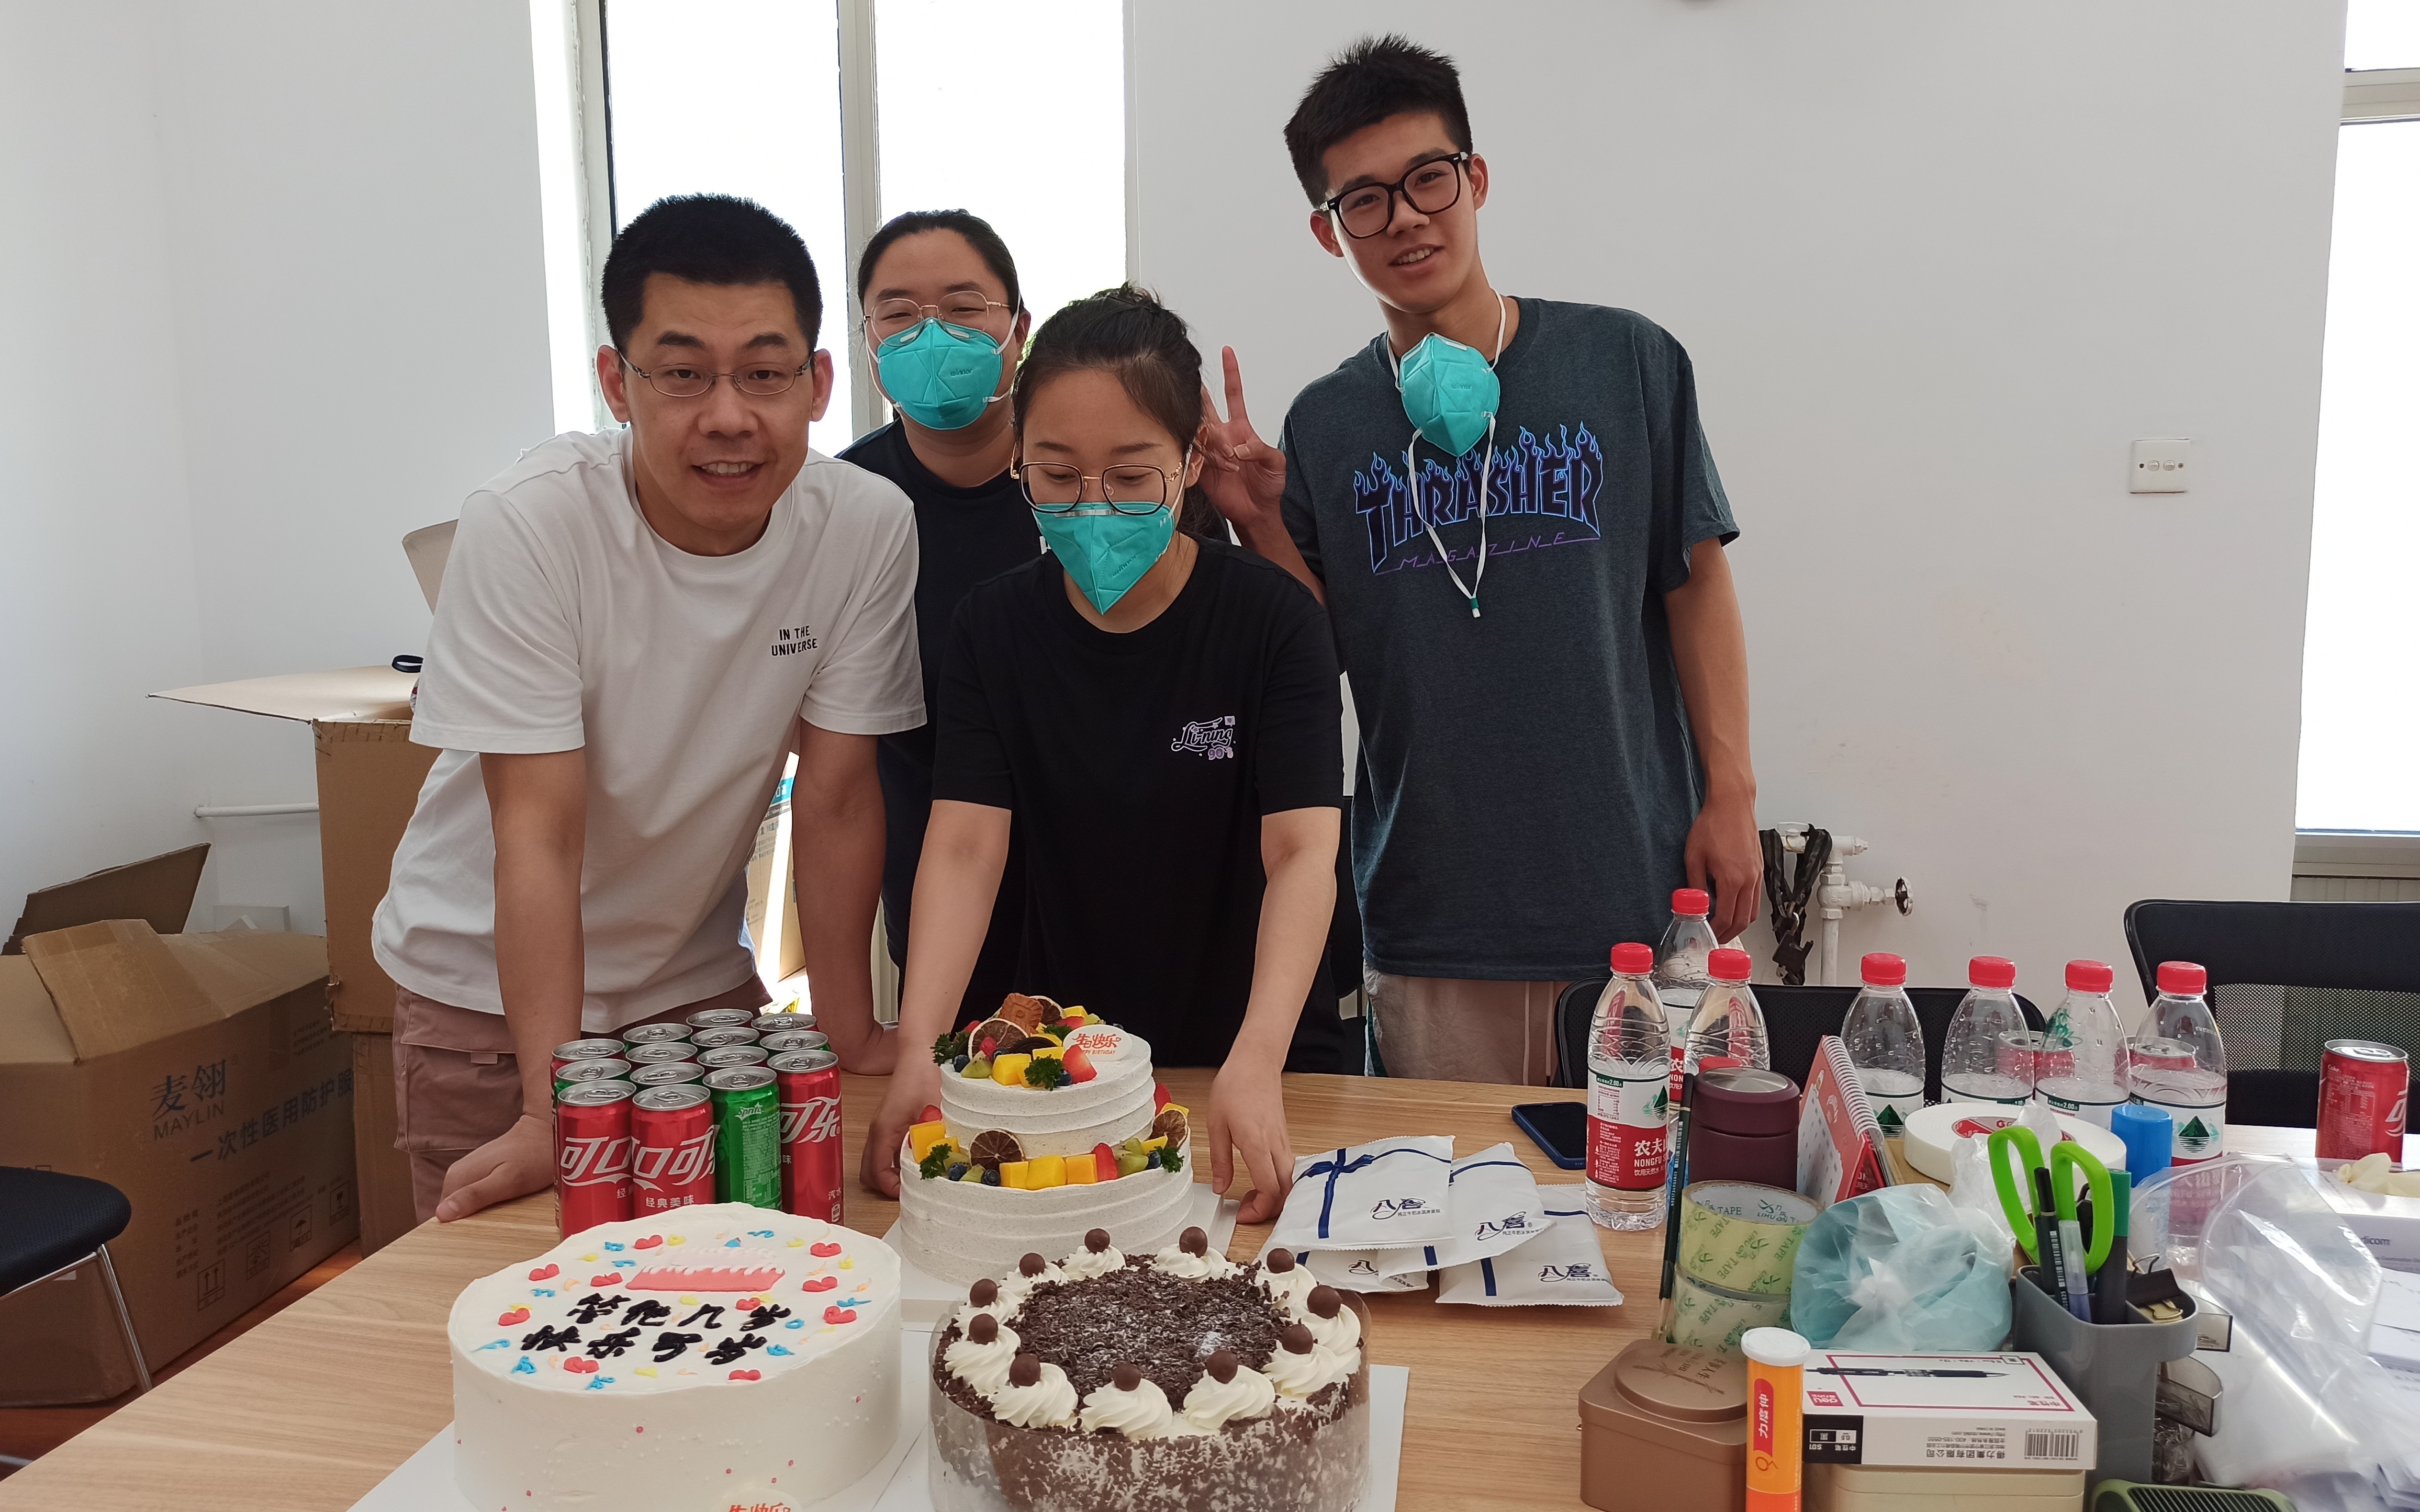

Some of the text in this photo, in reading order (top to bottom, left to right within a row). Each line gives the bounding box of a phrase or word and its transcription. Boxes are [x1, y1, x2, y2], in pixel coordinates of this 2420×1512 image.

[950, 368, 972, 377] winner
[1353, 421, 1604, 573] THRASHER
[1399, 532, 1565, 571] MAGAZINE
[779, 625, 810, 641] IN THE
[771, 638, 817, 657] UNIVERSE
[1072, 1033, 1122, 1049] 生日快乐
[154, 1102, 224, 1141] MAYLIN
[190, 1068, 354, 1163] 一次性医用防护服
[1634, 1155, 1662, 1168] NONGFU
[645, 1194, 694, 1208] 经典美味
[1371, 1198, 1426, 1219] 八喜
[1718, 1206, 1742, 1215] TAPE
[1475, 1211, 1527, 1240] 八喜
[2360, 1235, 2391, 1246] dicom
[1349, 1259, 1378, 1275] 八
[1538, 1263, 1592, 1282] 八喜
[1758, 1393, 1769, 1439] 力度伸
[1926, 1449, 2006, 1459] 得力集团有限公司
